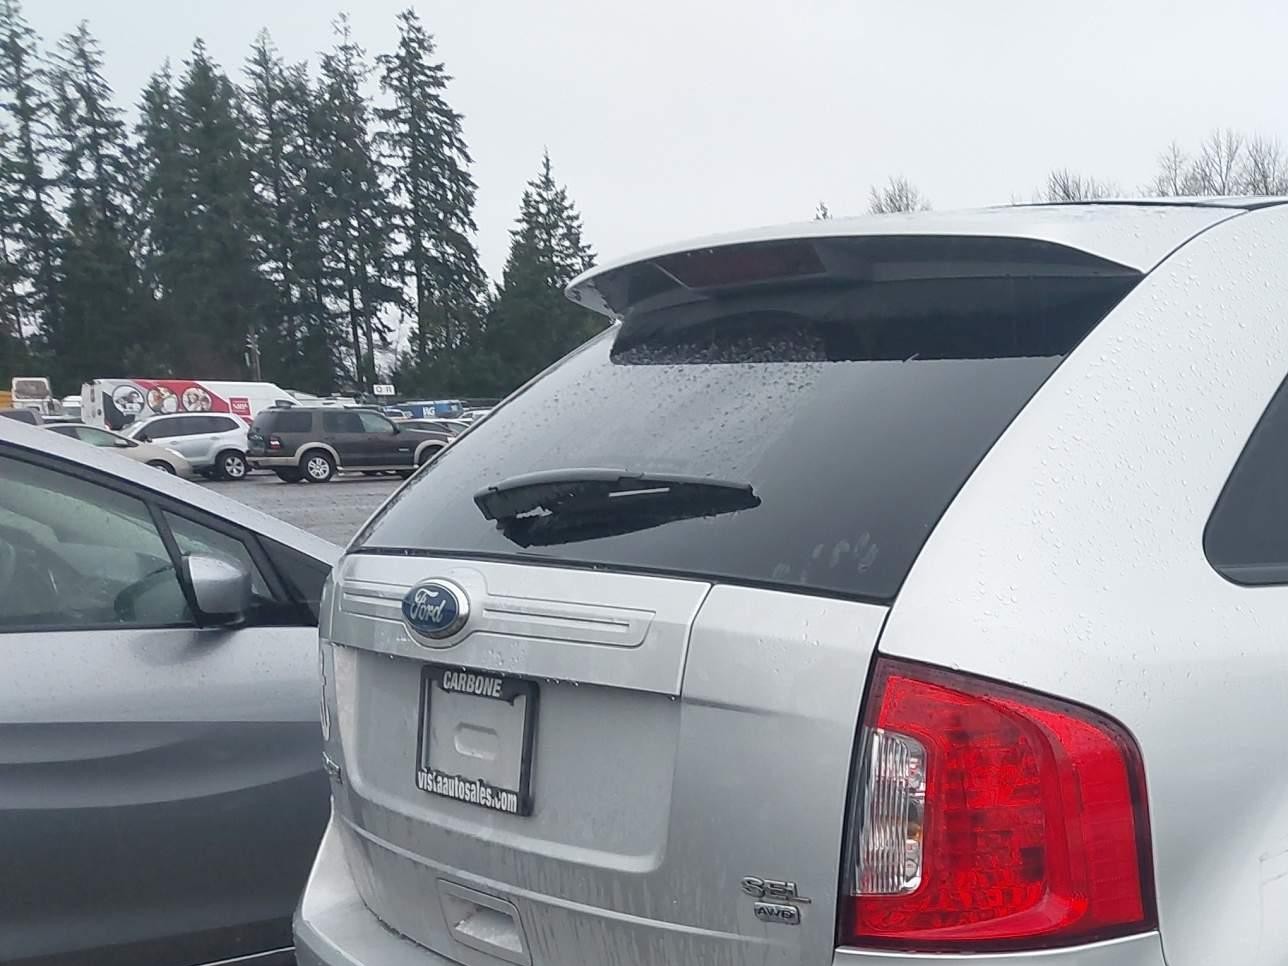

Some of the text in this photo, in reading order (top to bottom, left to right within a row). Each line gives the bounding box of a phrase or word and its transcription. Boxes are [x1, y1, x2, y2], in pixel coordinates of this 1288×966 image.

[410, 588, 446, 623] Ford
[443, 671, 503, 697] CARBONE
[418, 768, 518, 812] vistaautosales.com
[741, 876, 812, 903] SEL
[757, 906, 795, 919] AWD
